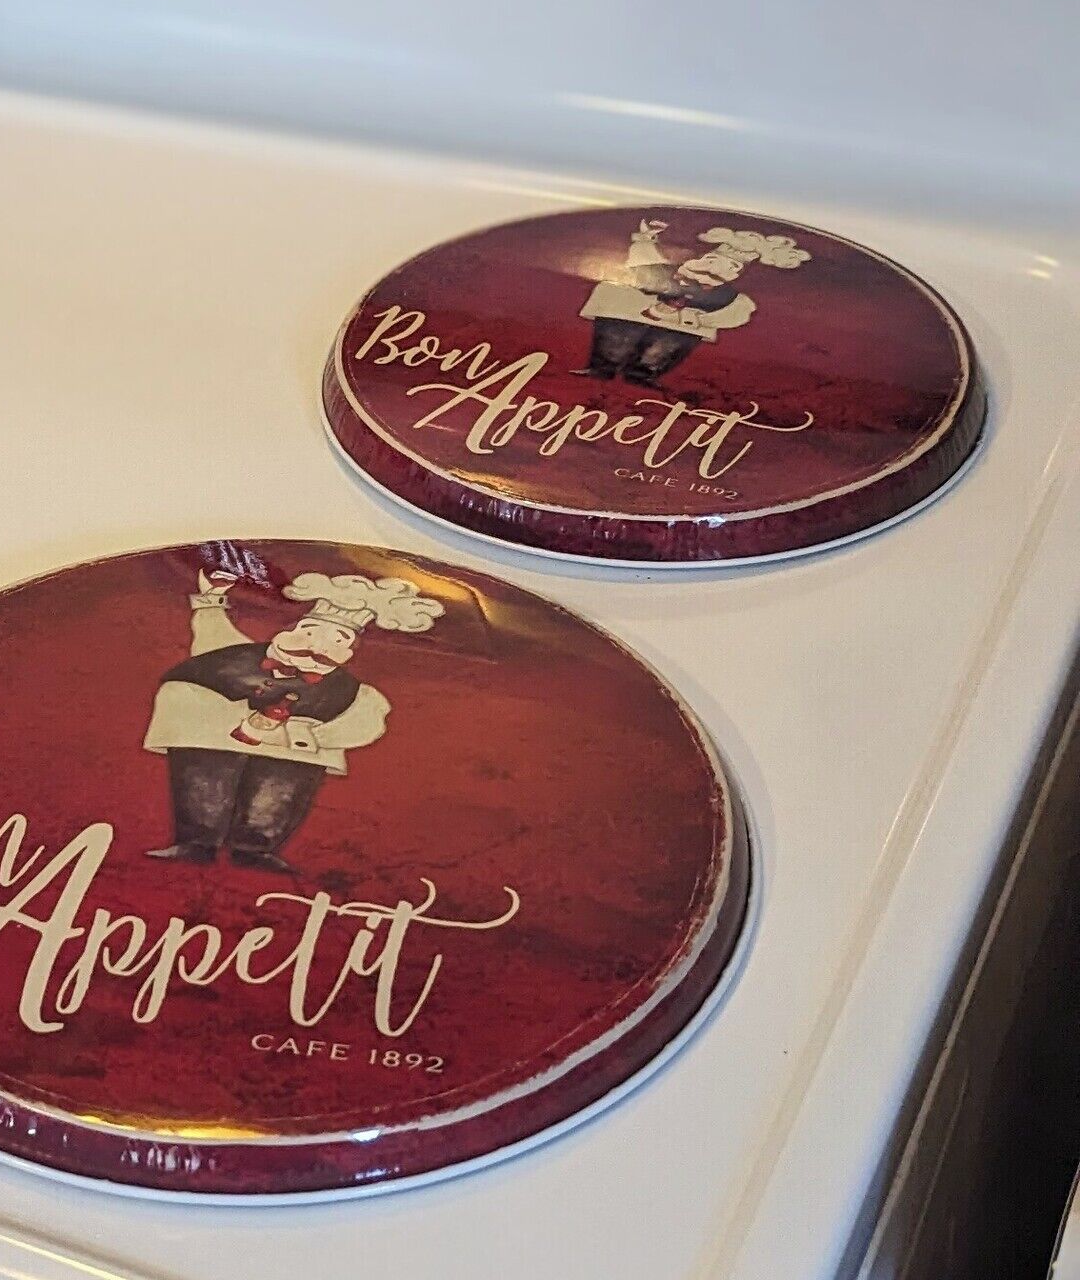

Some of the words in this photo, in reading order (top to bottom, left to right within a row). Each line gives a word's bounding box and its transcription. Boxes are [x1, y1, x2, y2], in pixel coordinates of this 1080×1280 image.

[354, 305, 489, 379] Bon
[406, 352, 814, 480] Appetit
[613, 467, 679, 488] CAFE
[687, 481, 739, 500] 1892
[251, 1032, 350, 1063] CAFE
[366, 1047, 446, 1074] 1892
